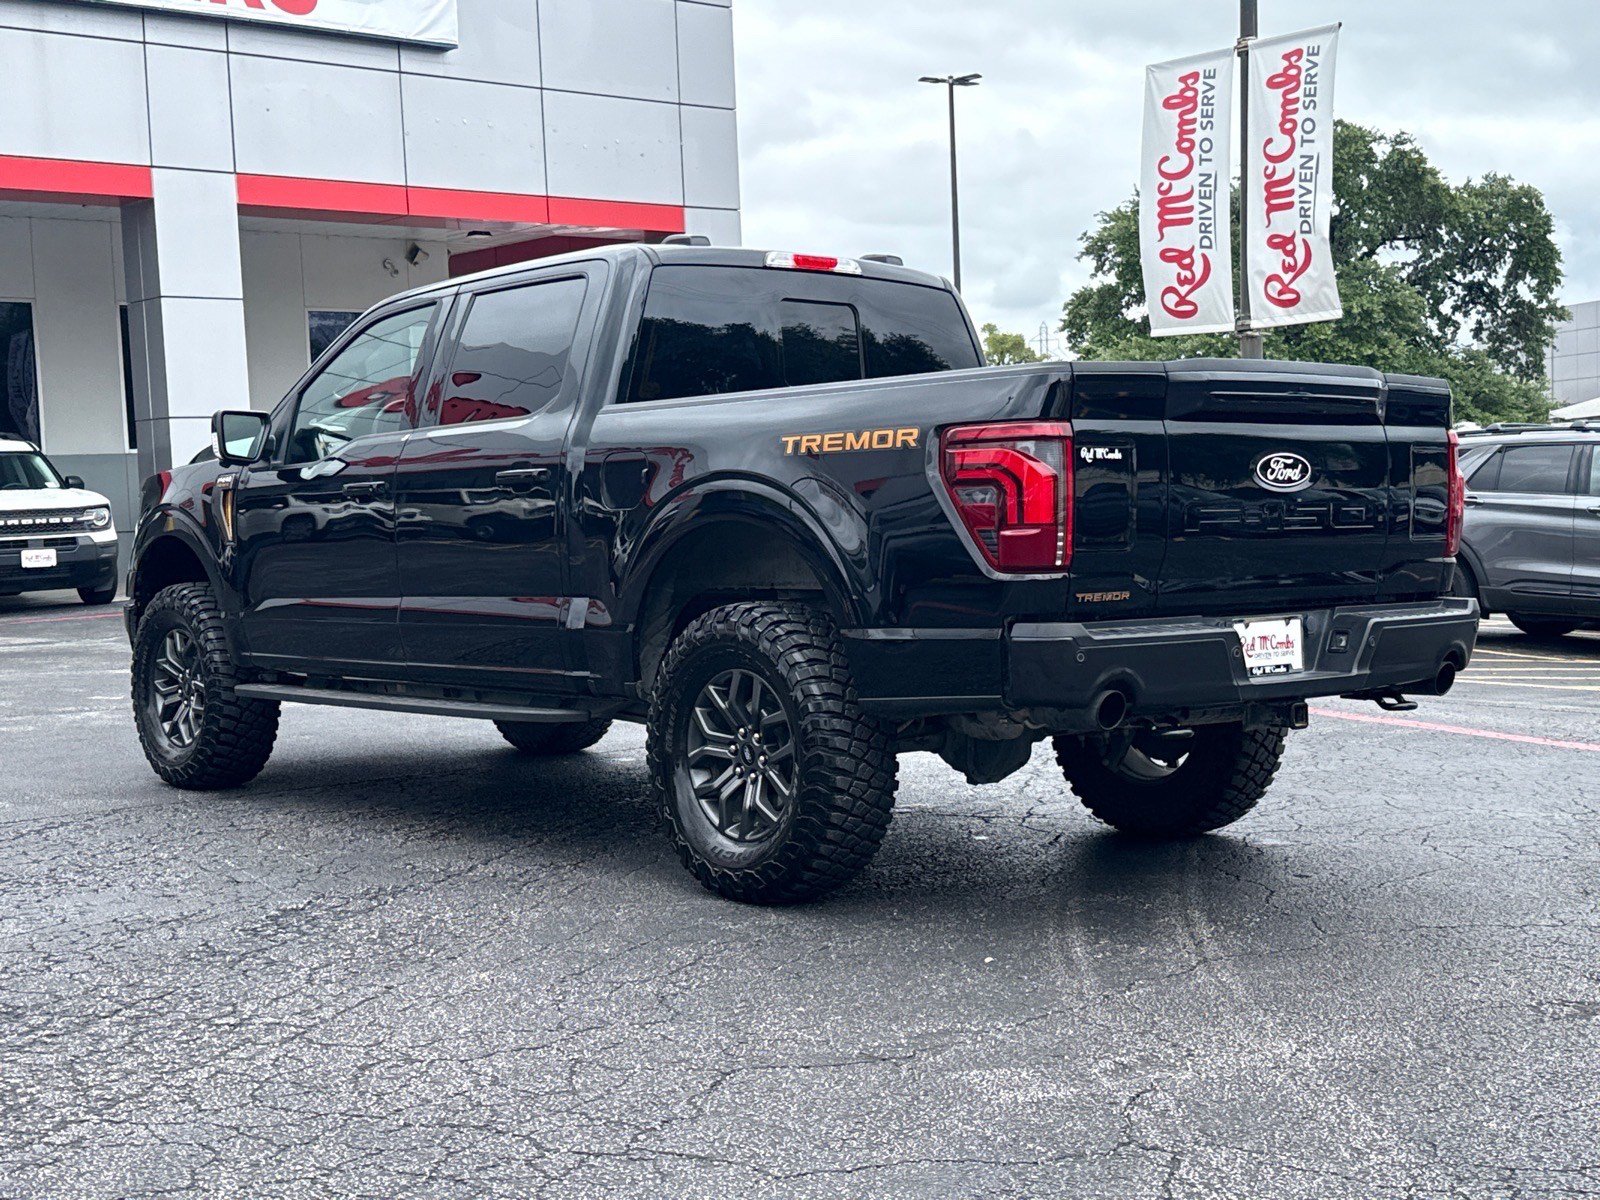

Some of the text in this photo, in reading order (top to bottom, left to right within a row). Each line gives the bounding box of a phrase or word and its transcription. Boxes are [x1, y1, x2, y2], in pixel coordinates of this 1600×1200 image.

[1157, 71, 1211, 319] Red McCombs
[1199, 68, 1216, 249] DRIVEN TO SERVE
[1263, 48, 1312, 308] Red McCombs
[1299, 45, 1320, 234] DRIVEN TO SERVE
[781, 428, 919, 454] TREMOR
[1267, 457, 1302, 481] Ford
[1075, 591, 1130, 602] TREMOR
